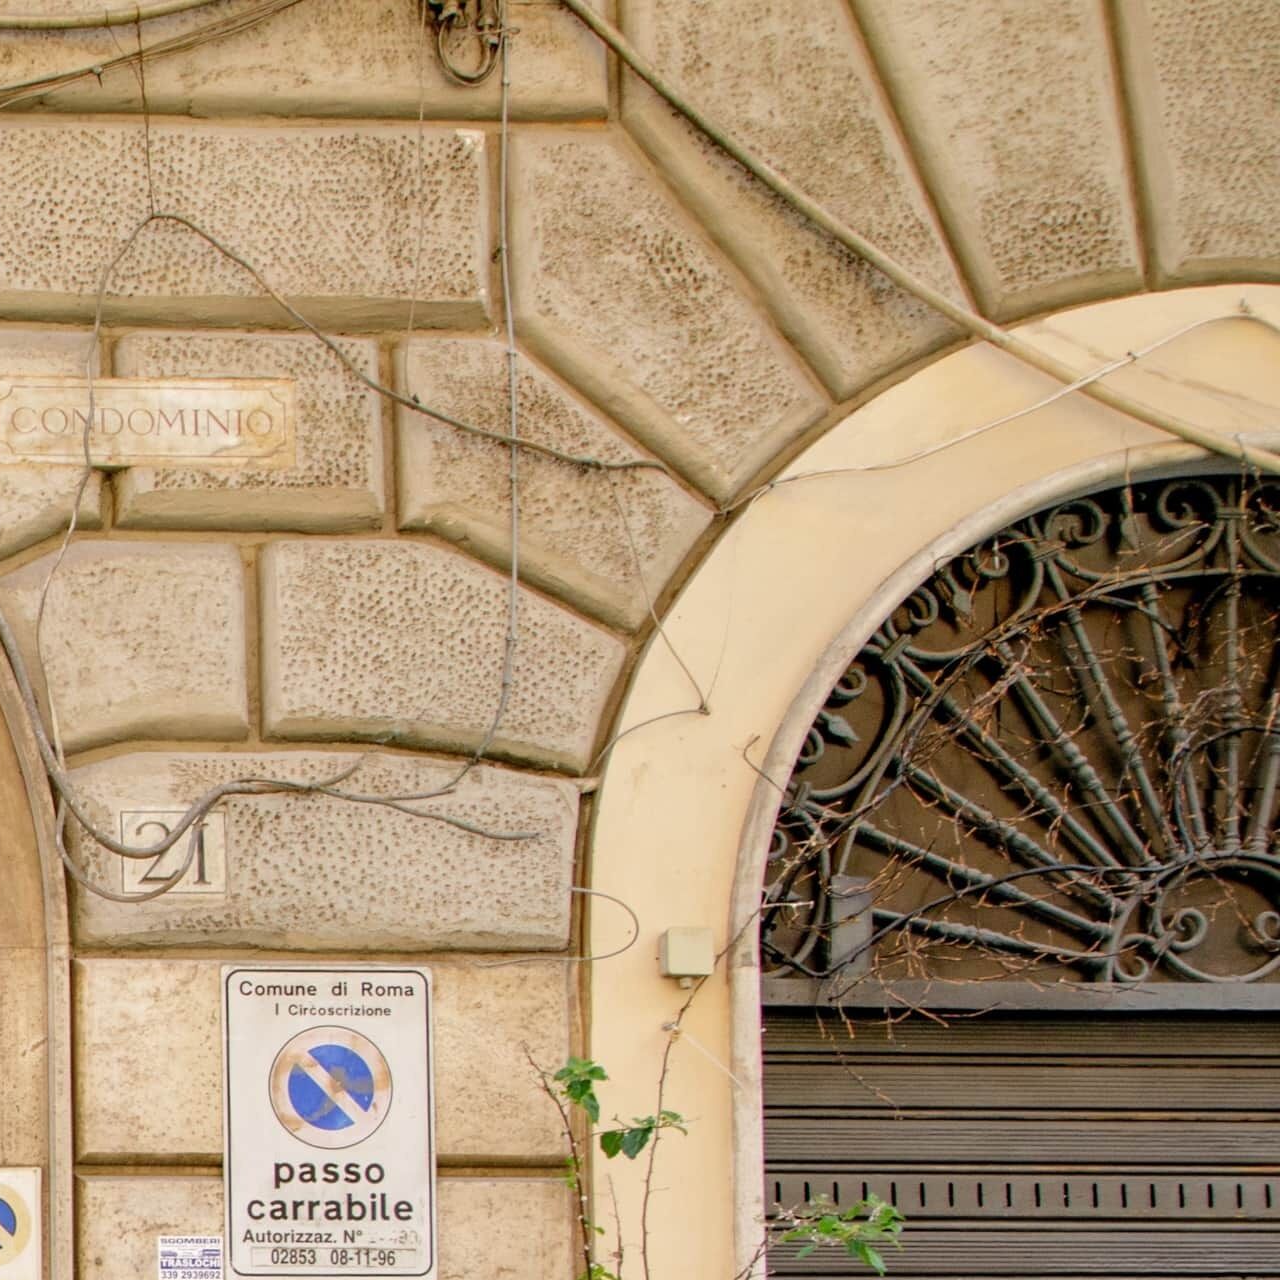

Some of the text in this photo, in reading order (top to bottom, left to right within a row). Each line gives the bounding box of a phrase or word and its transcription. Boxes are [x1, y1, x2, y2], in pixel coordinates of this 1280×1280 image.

[10, 406, 274, 437] CONDOMINIO
[135, 821, 212, 885] 21
[239, 980, 415, 997] Comune di Roma
[288, 1003, 392, 1017] Circoscrizione
[273, 1161, 385, 1189] passo
[246, 1192, 414, 1222] carrabile
[242, 1229, 338, 1244] Autorizzaz.
[270, 1249, 396, 1266] 02853 08-11-96
